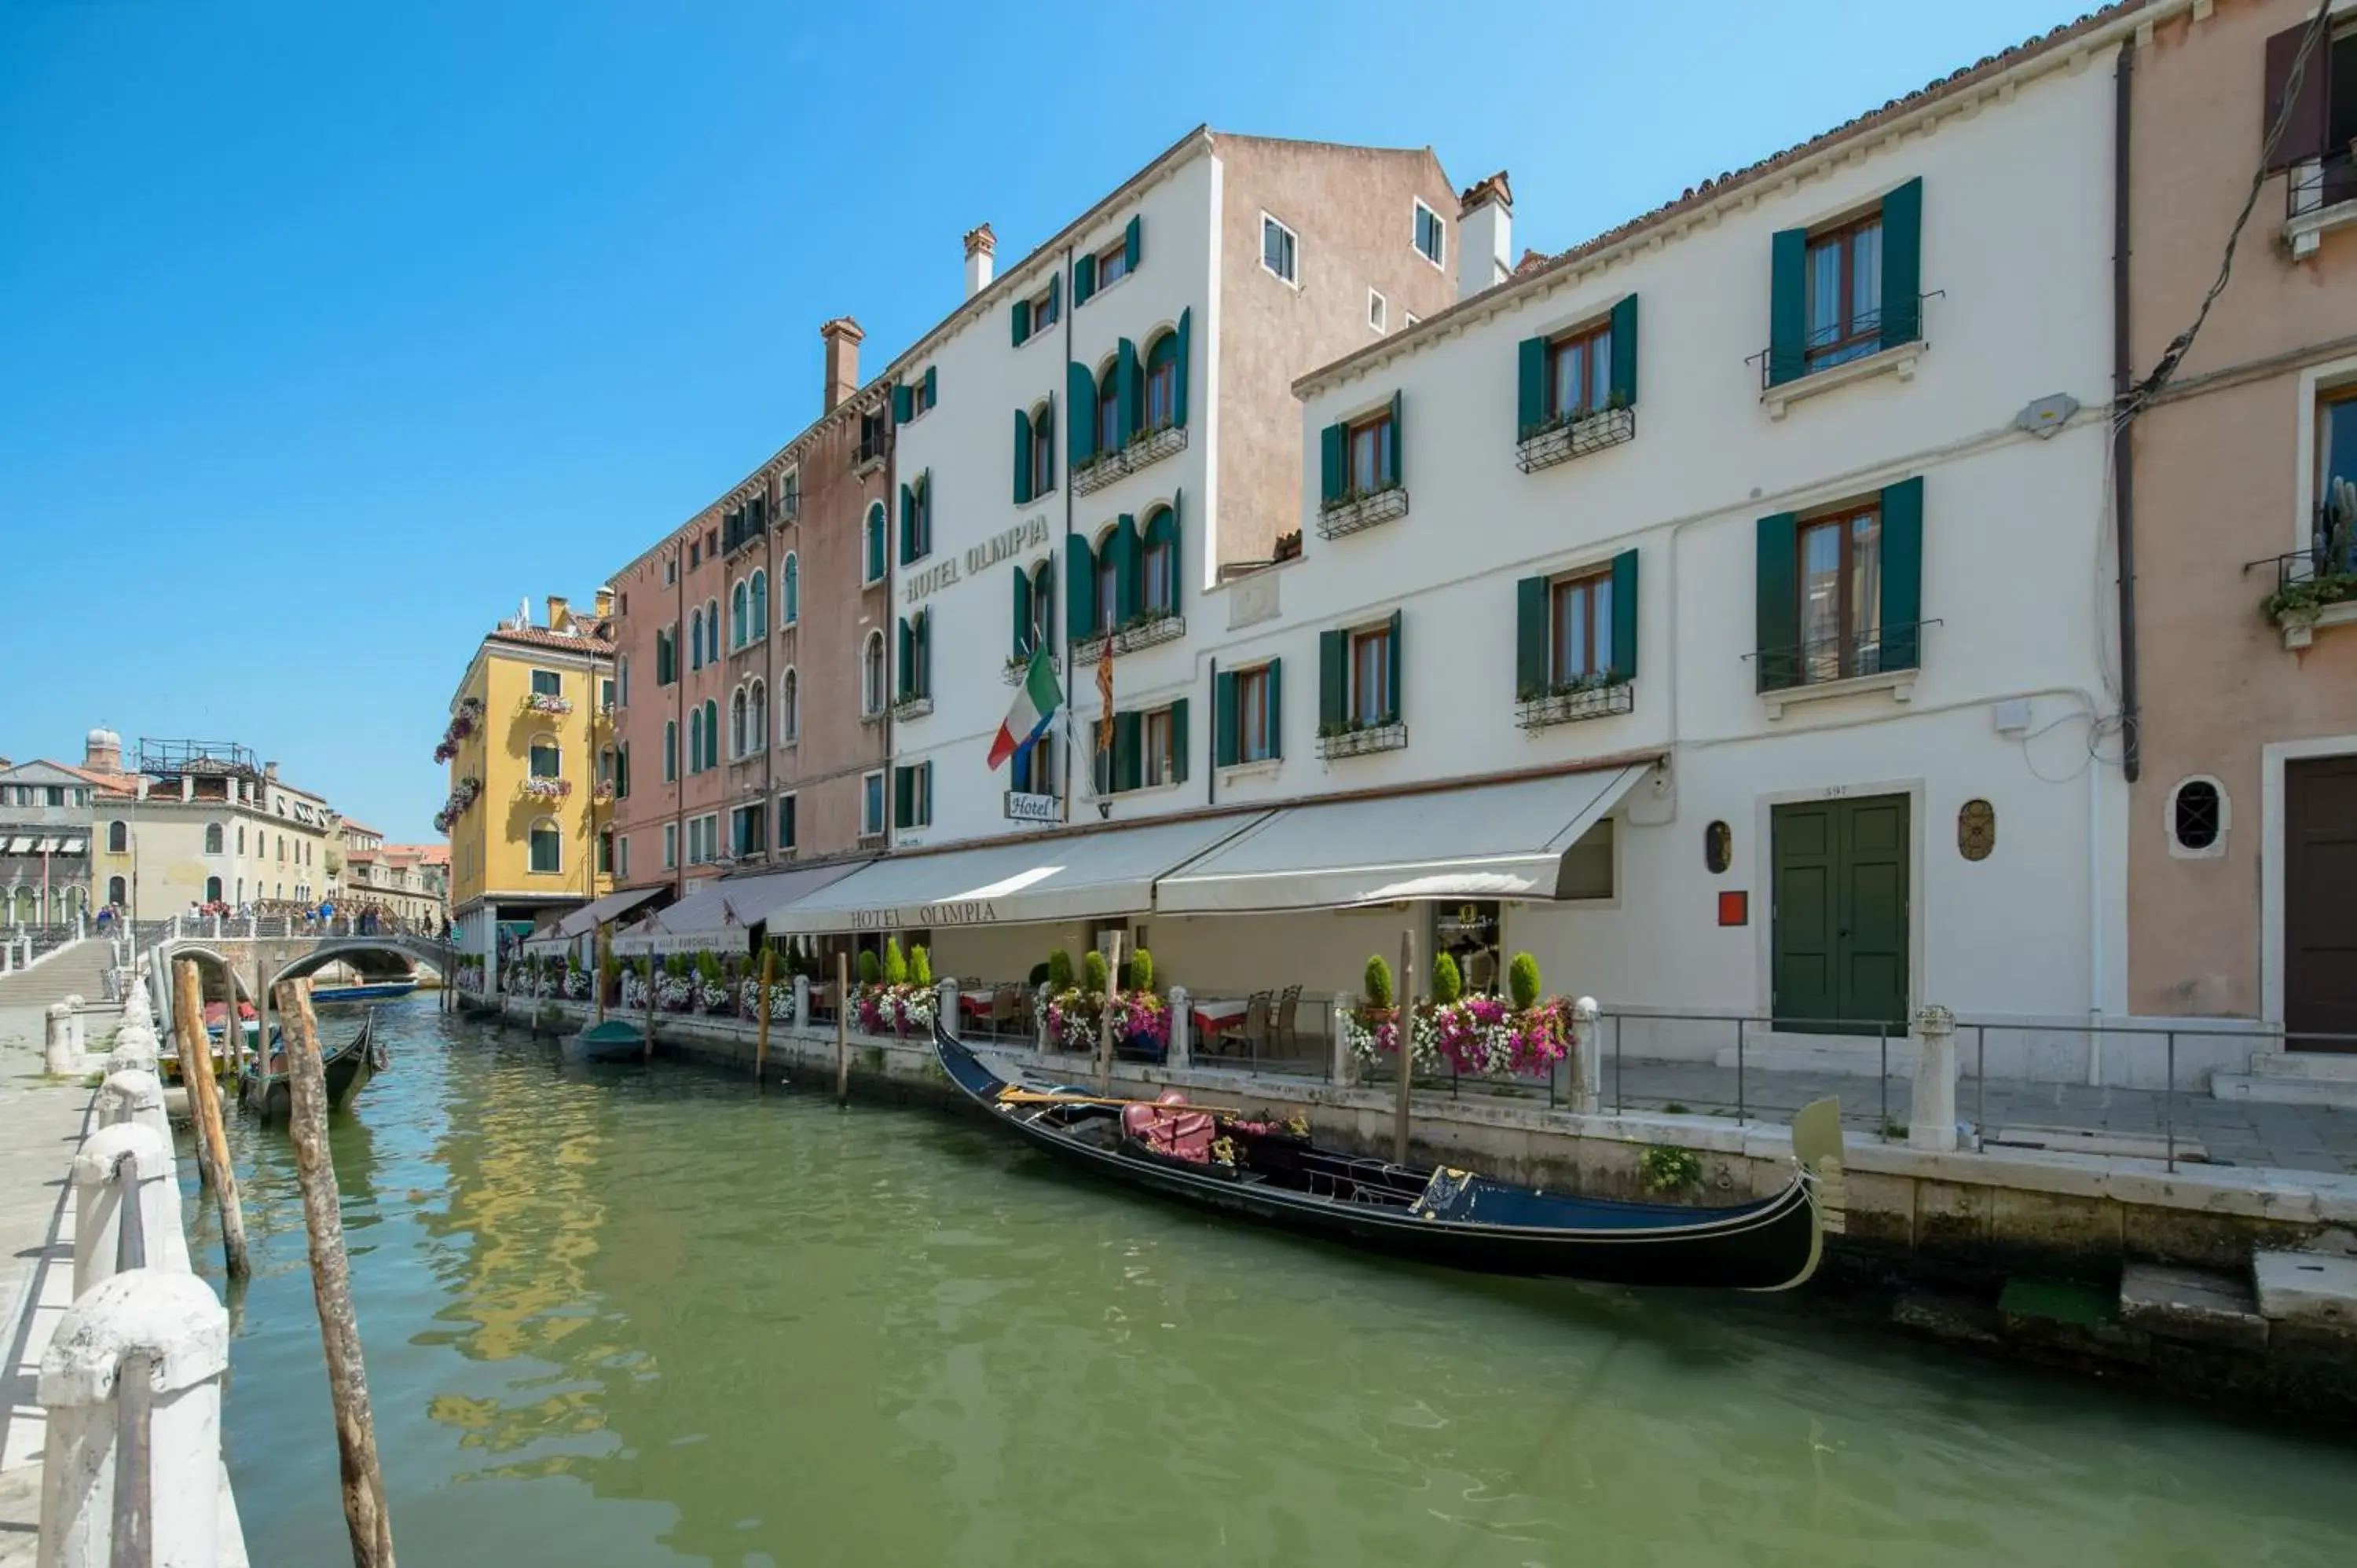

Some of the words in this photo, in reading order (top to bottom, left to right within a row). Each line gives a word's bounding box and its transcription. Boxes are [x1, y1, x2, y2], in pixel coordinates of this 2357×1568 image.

[906, 557, 962, 603] HOTEL
[966, 514, 1049, 576] OLIMPIA
[1012, 796, 1051, 816] Hotel
[851, 907, 901, 929] HOTEL
[920, 901, 997, 925] OLIMPIA
